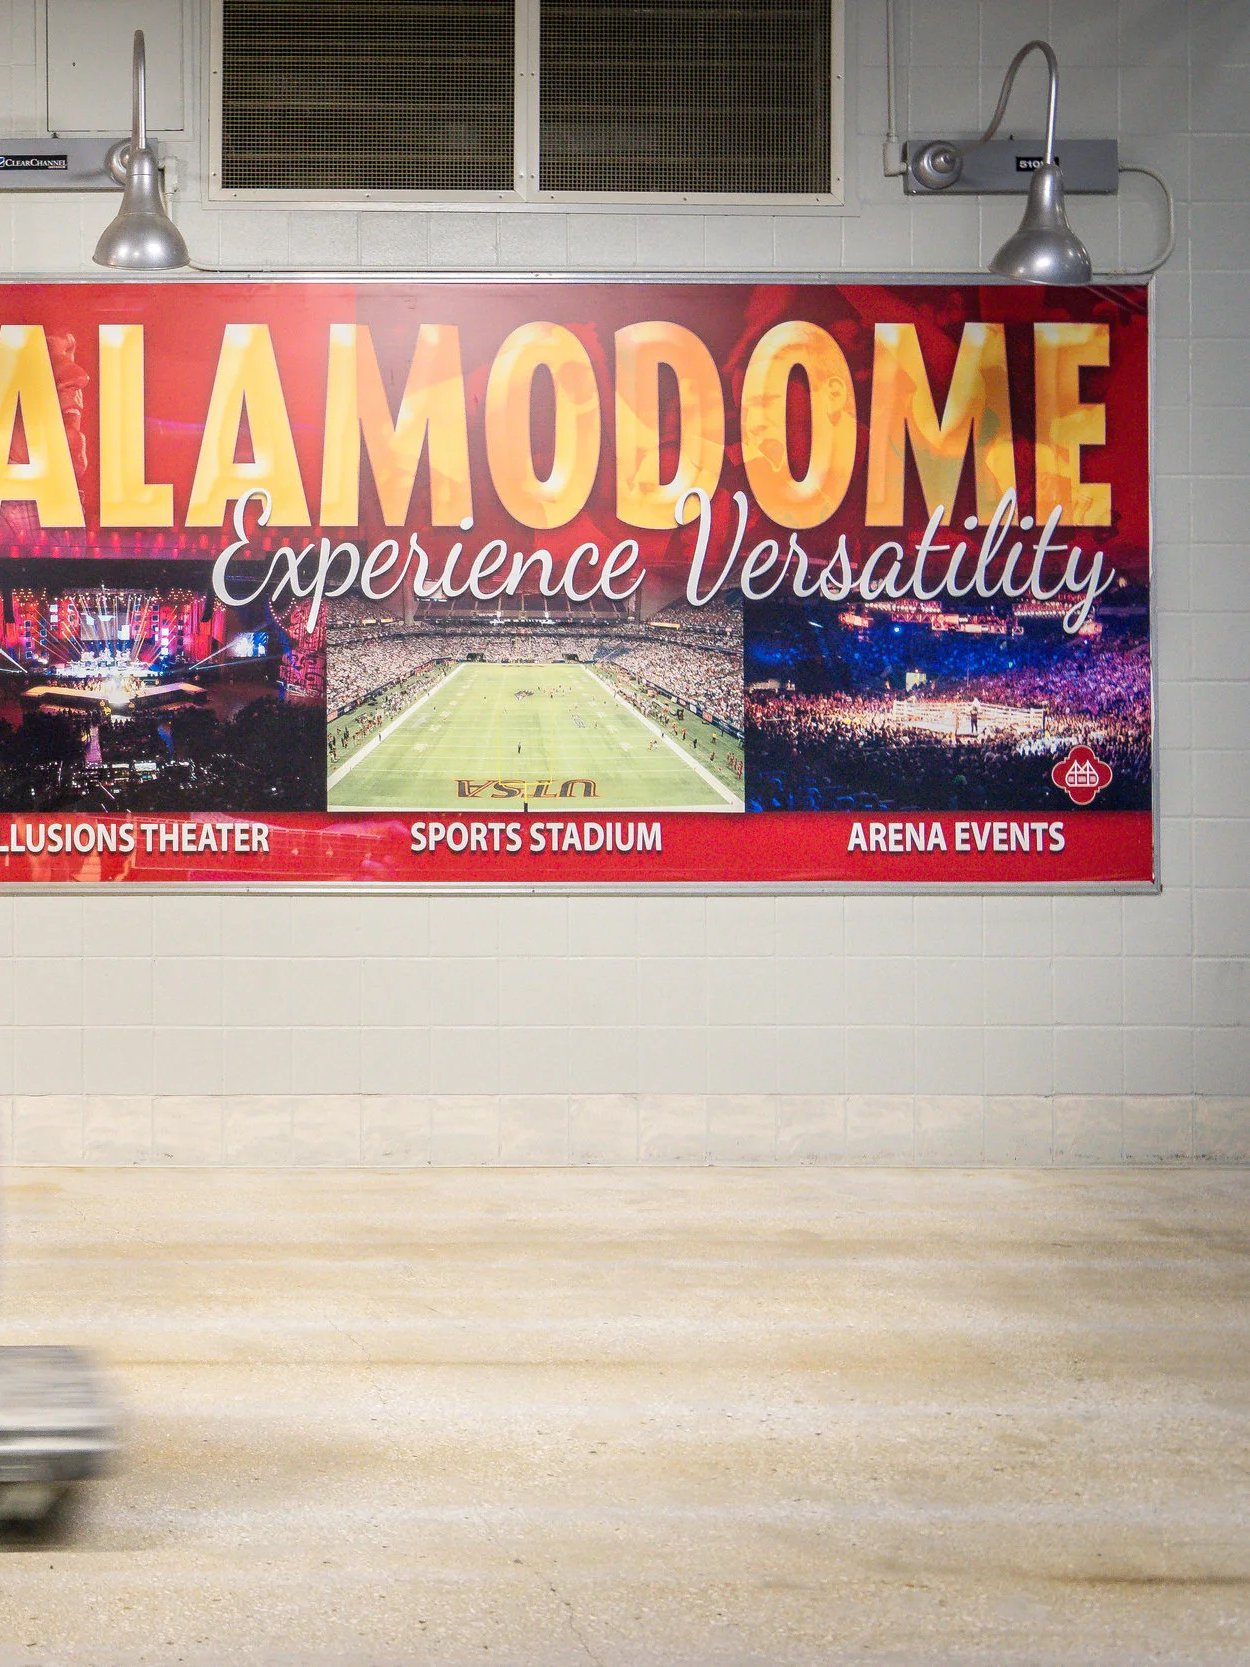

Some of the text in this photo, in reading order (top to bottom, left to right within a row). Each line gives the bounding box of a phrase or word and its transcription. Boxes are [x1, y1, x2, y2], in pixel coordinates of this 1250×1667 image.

[212, 487, 1116, 635] Experience Versatility
[454, 779, 603, 799] UTSA
[141, 822, 270, 853] THEATER
[411, 822, 662, 852] SPORTS STADIUM
[847, 821, 1065, 852] ARENA EVENTS
